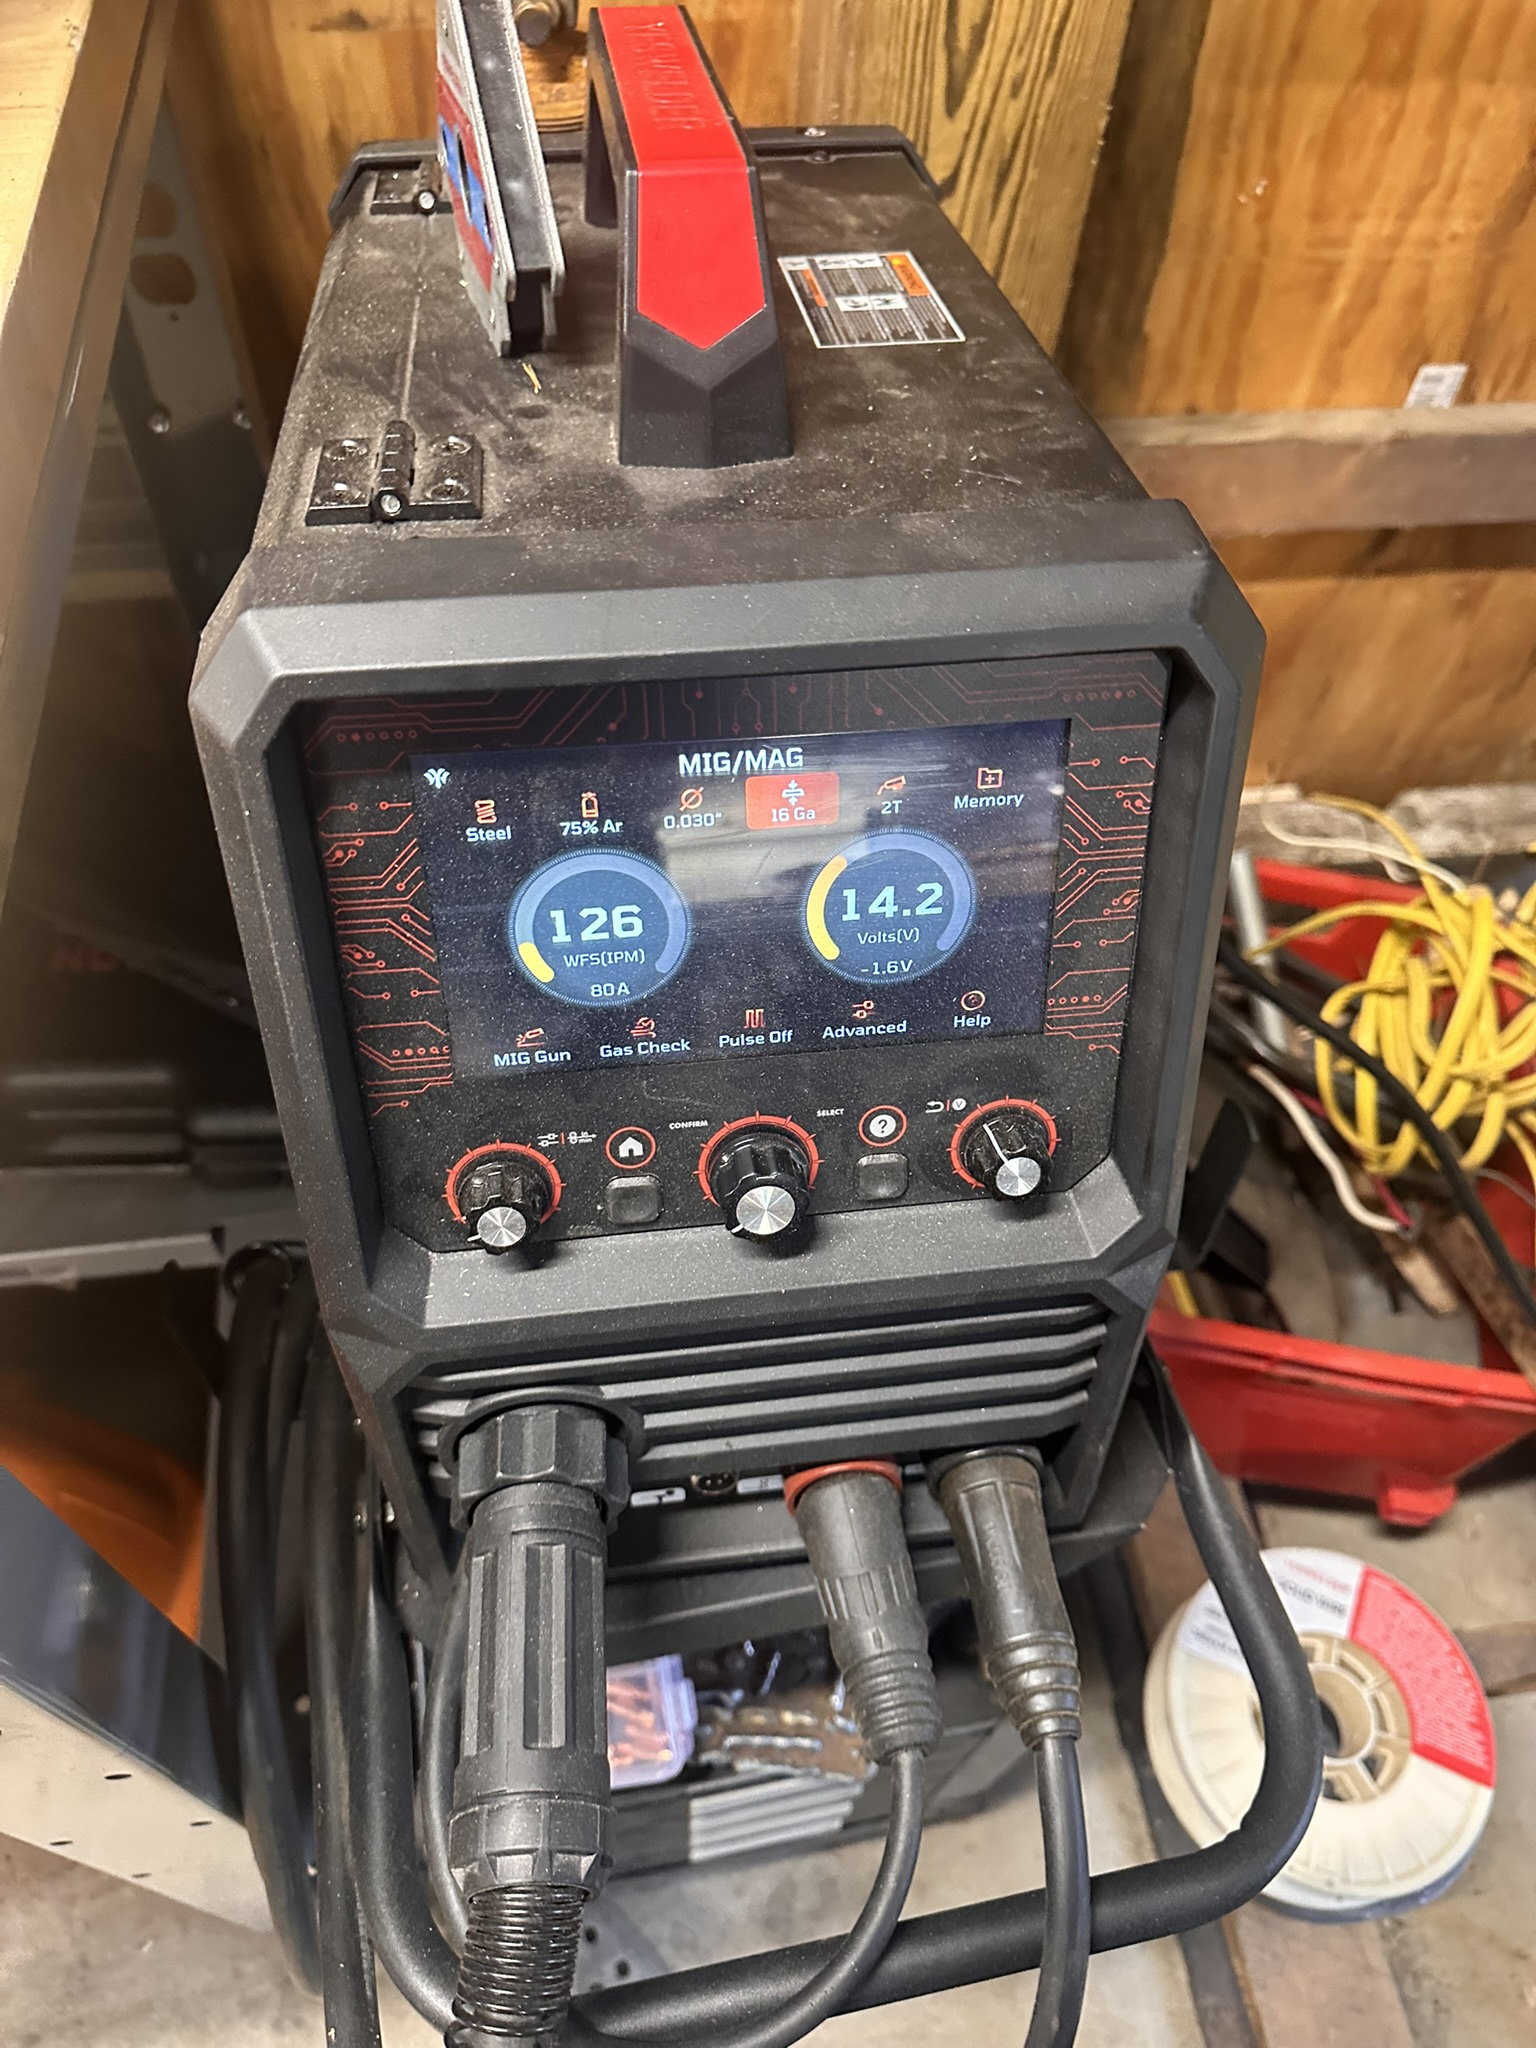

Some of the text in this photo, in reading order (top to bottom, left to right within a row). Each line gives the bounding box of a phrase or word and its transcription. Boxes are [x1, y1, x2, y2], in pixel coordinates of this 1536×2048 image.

[678, 747, 804, 776] MIG/MAG
[881, 800, 902, 815] 2T
[954, 793, 1025, 810] Memory
[771, 807, 816, 823] 16 Ga
[466, 826, 512, 842] Steel
[559, 819, 624, 837] 75% Ar
[841, 882, 944, 922] 14.2
[549, 904, 644, 943] 126
[857, 927, 920, 945] Volts(V)
[563, 948, 646, 968] WFS(IPM)
[822, 1021, 907, 1039] Advanced
[953, 1014, 991, 1030] Help
[719, 1030, 793, 1048] Pulse Off
[600, 1039, 691, 1059] Gas Check
[494, 1050, 572, 1067] MIG Gun
[816, 1108, 845, 1117] SELECT
[668, 1120, 709, 1130] CONFIRM
